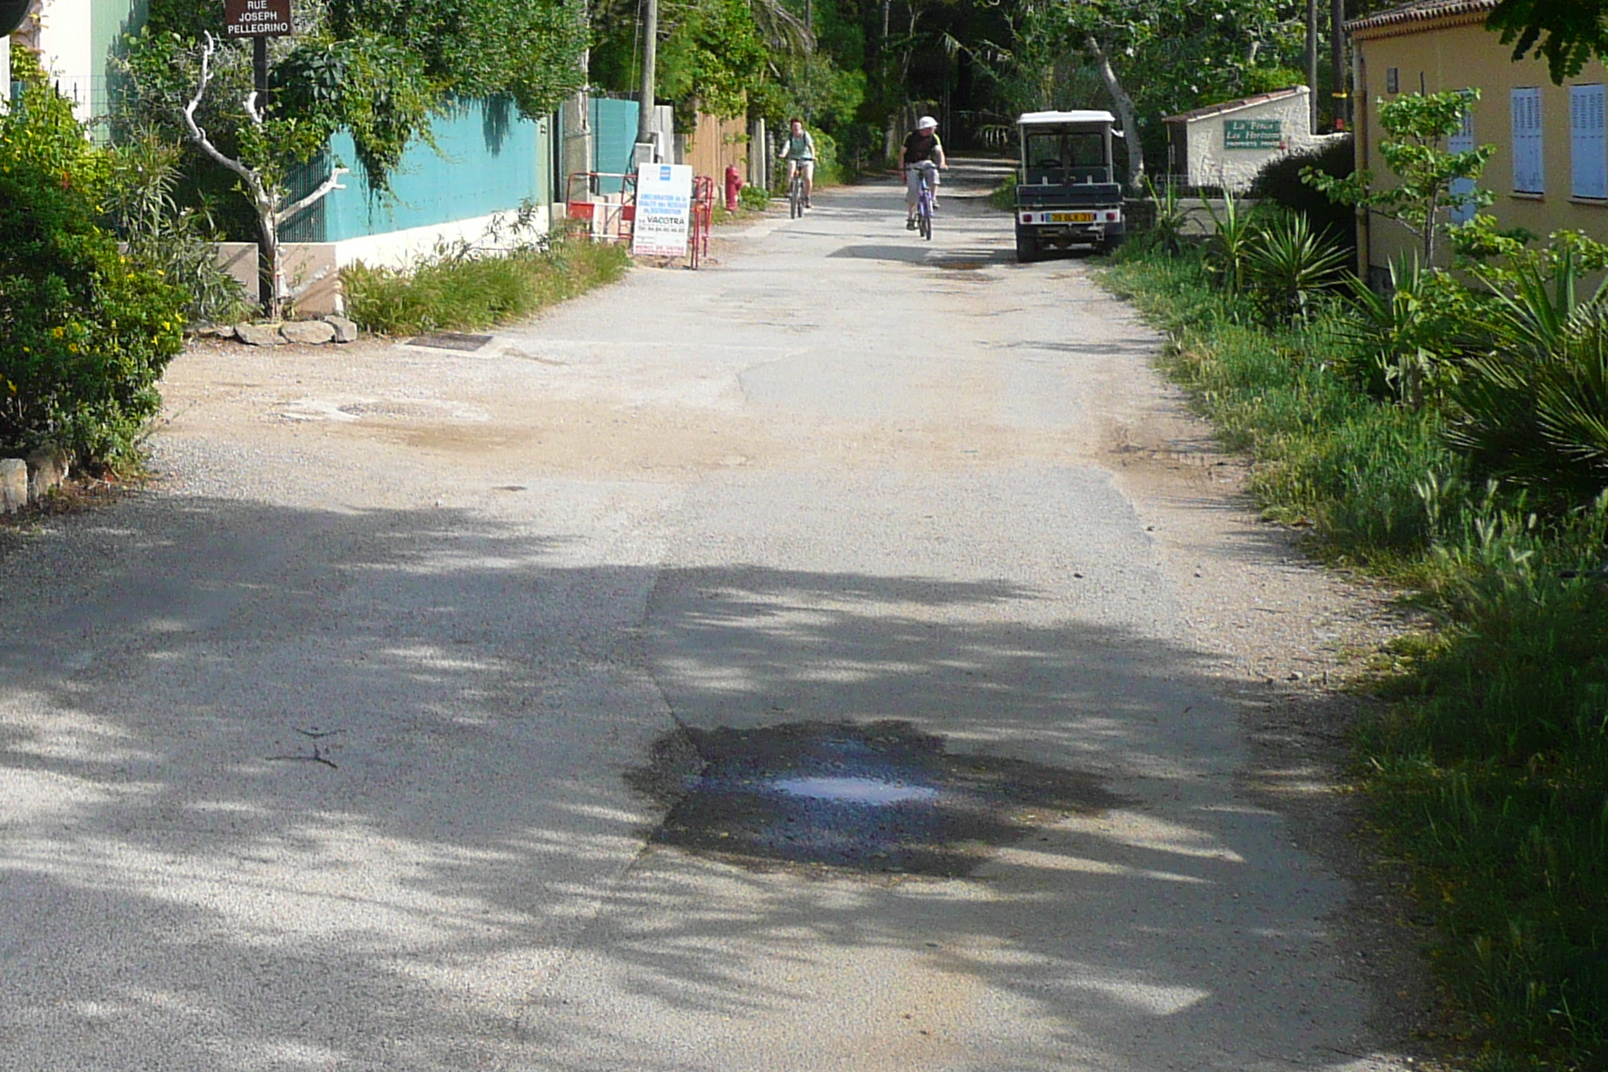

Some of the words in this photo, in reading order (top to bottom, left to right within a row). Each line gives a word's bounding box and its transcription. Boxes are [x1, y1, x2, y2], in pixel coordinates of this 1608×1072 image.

[247, 0, 268, 10] RUE
[239, 11, 278, 22] JOSEPH
[228, 22, 288, 34] PELLEGRINO
[646, 216, 685, 225] VACOTRA
